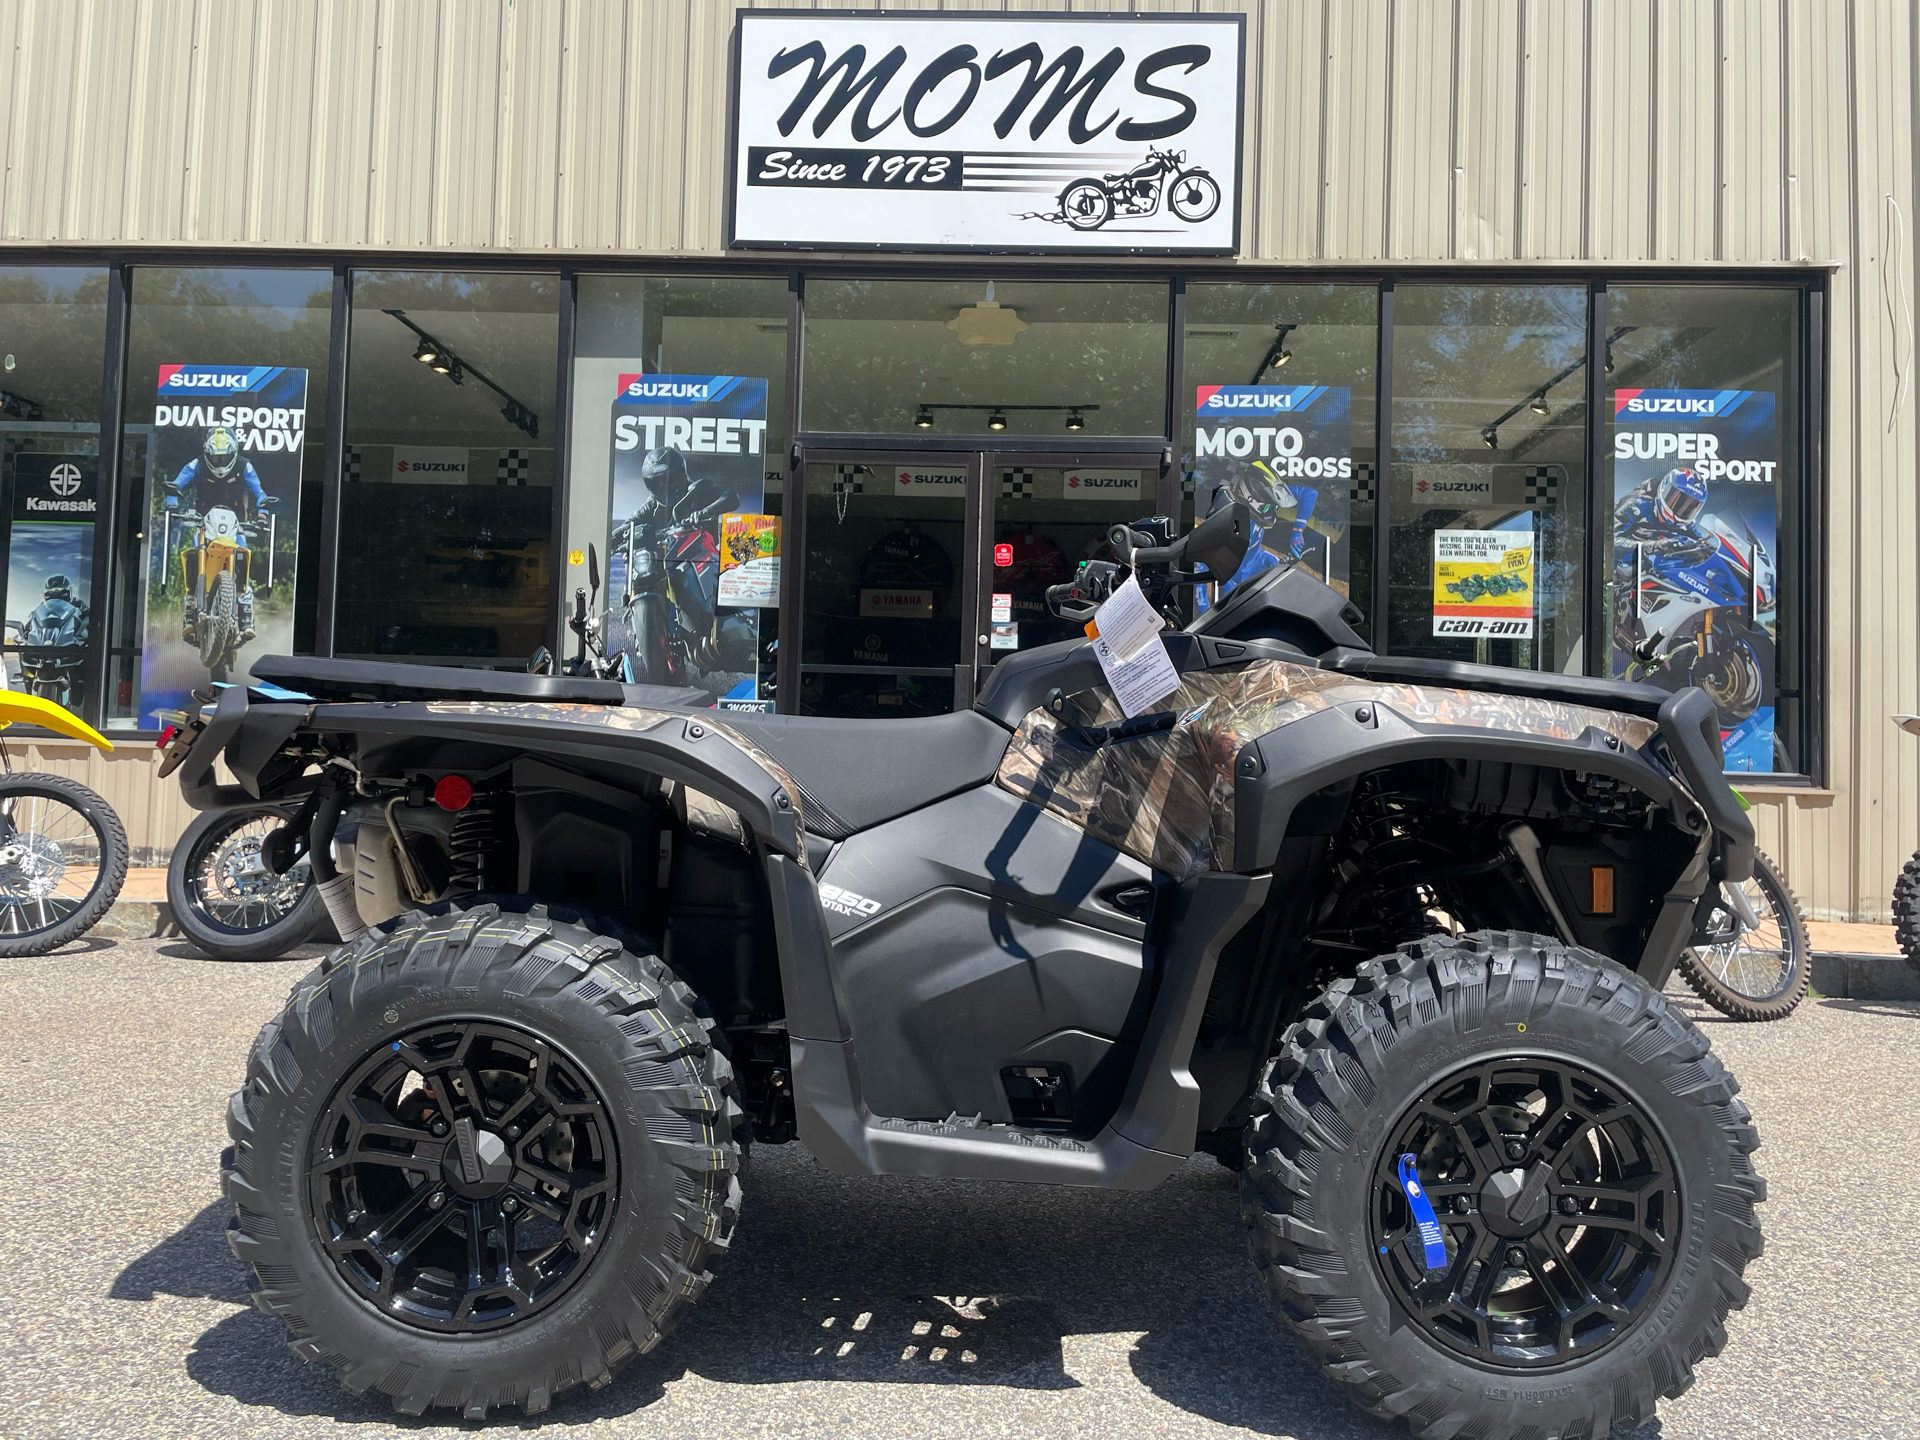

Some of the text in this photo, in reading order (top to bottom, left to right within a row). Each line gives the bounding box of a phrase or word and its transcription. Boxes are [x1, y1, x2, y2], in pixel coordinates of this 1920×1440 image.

[767, 40, 1211, 144] MOMS
[758, 151, 951, 183] Since 1973
[169, 373, 248, 388] SUZUKI
[628, 382, 708, 397] SUZUKI
[1208, 394, 1291, 408] SUZUKI
[1627, 398, 1715, 413] SUZUKI
[614, 415, 766, 454] STREET
[1196, 426, 1303, 457] MOTO
[1614, 432, 1719, 460] SUPER
[412, 462, 465, 472] SUZUKI
[1270, 456, 1352, 478] CROSS
[1694, 459, 1777, 483] SPORT
[1083, 478, 1138, 488] SUZUKI
[1432, 482, 1490, 492] SUZUKI
[26, 497, 97, 512] Kawasak
[1507, 558, 1524, 568] EVENT
[1678, 571, 1710, 595] SUZUKI
[883, 595, 922, 606] YAMAHA
[1014, 600, 1044, 611] YAMAHA
[853, 649, 889, 662] YAMAHA
[819, 883, 882, 914] 850
